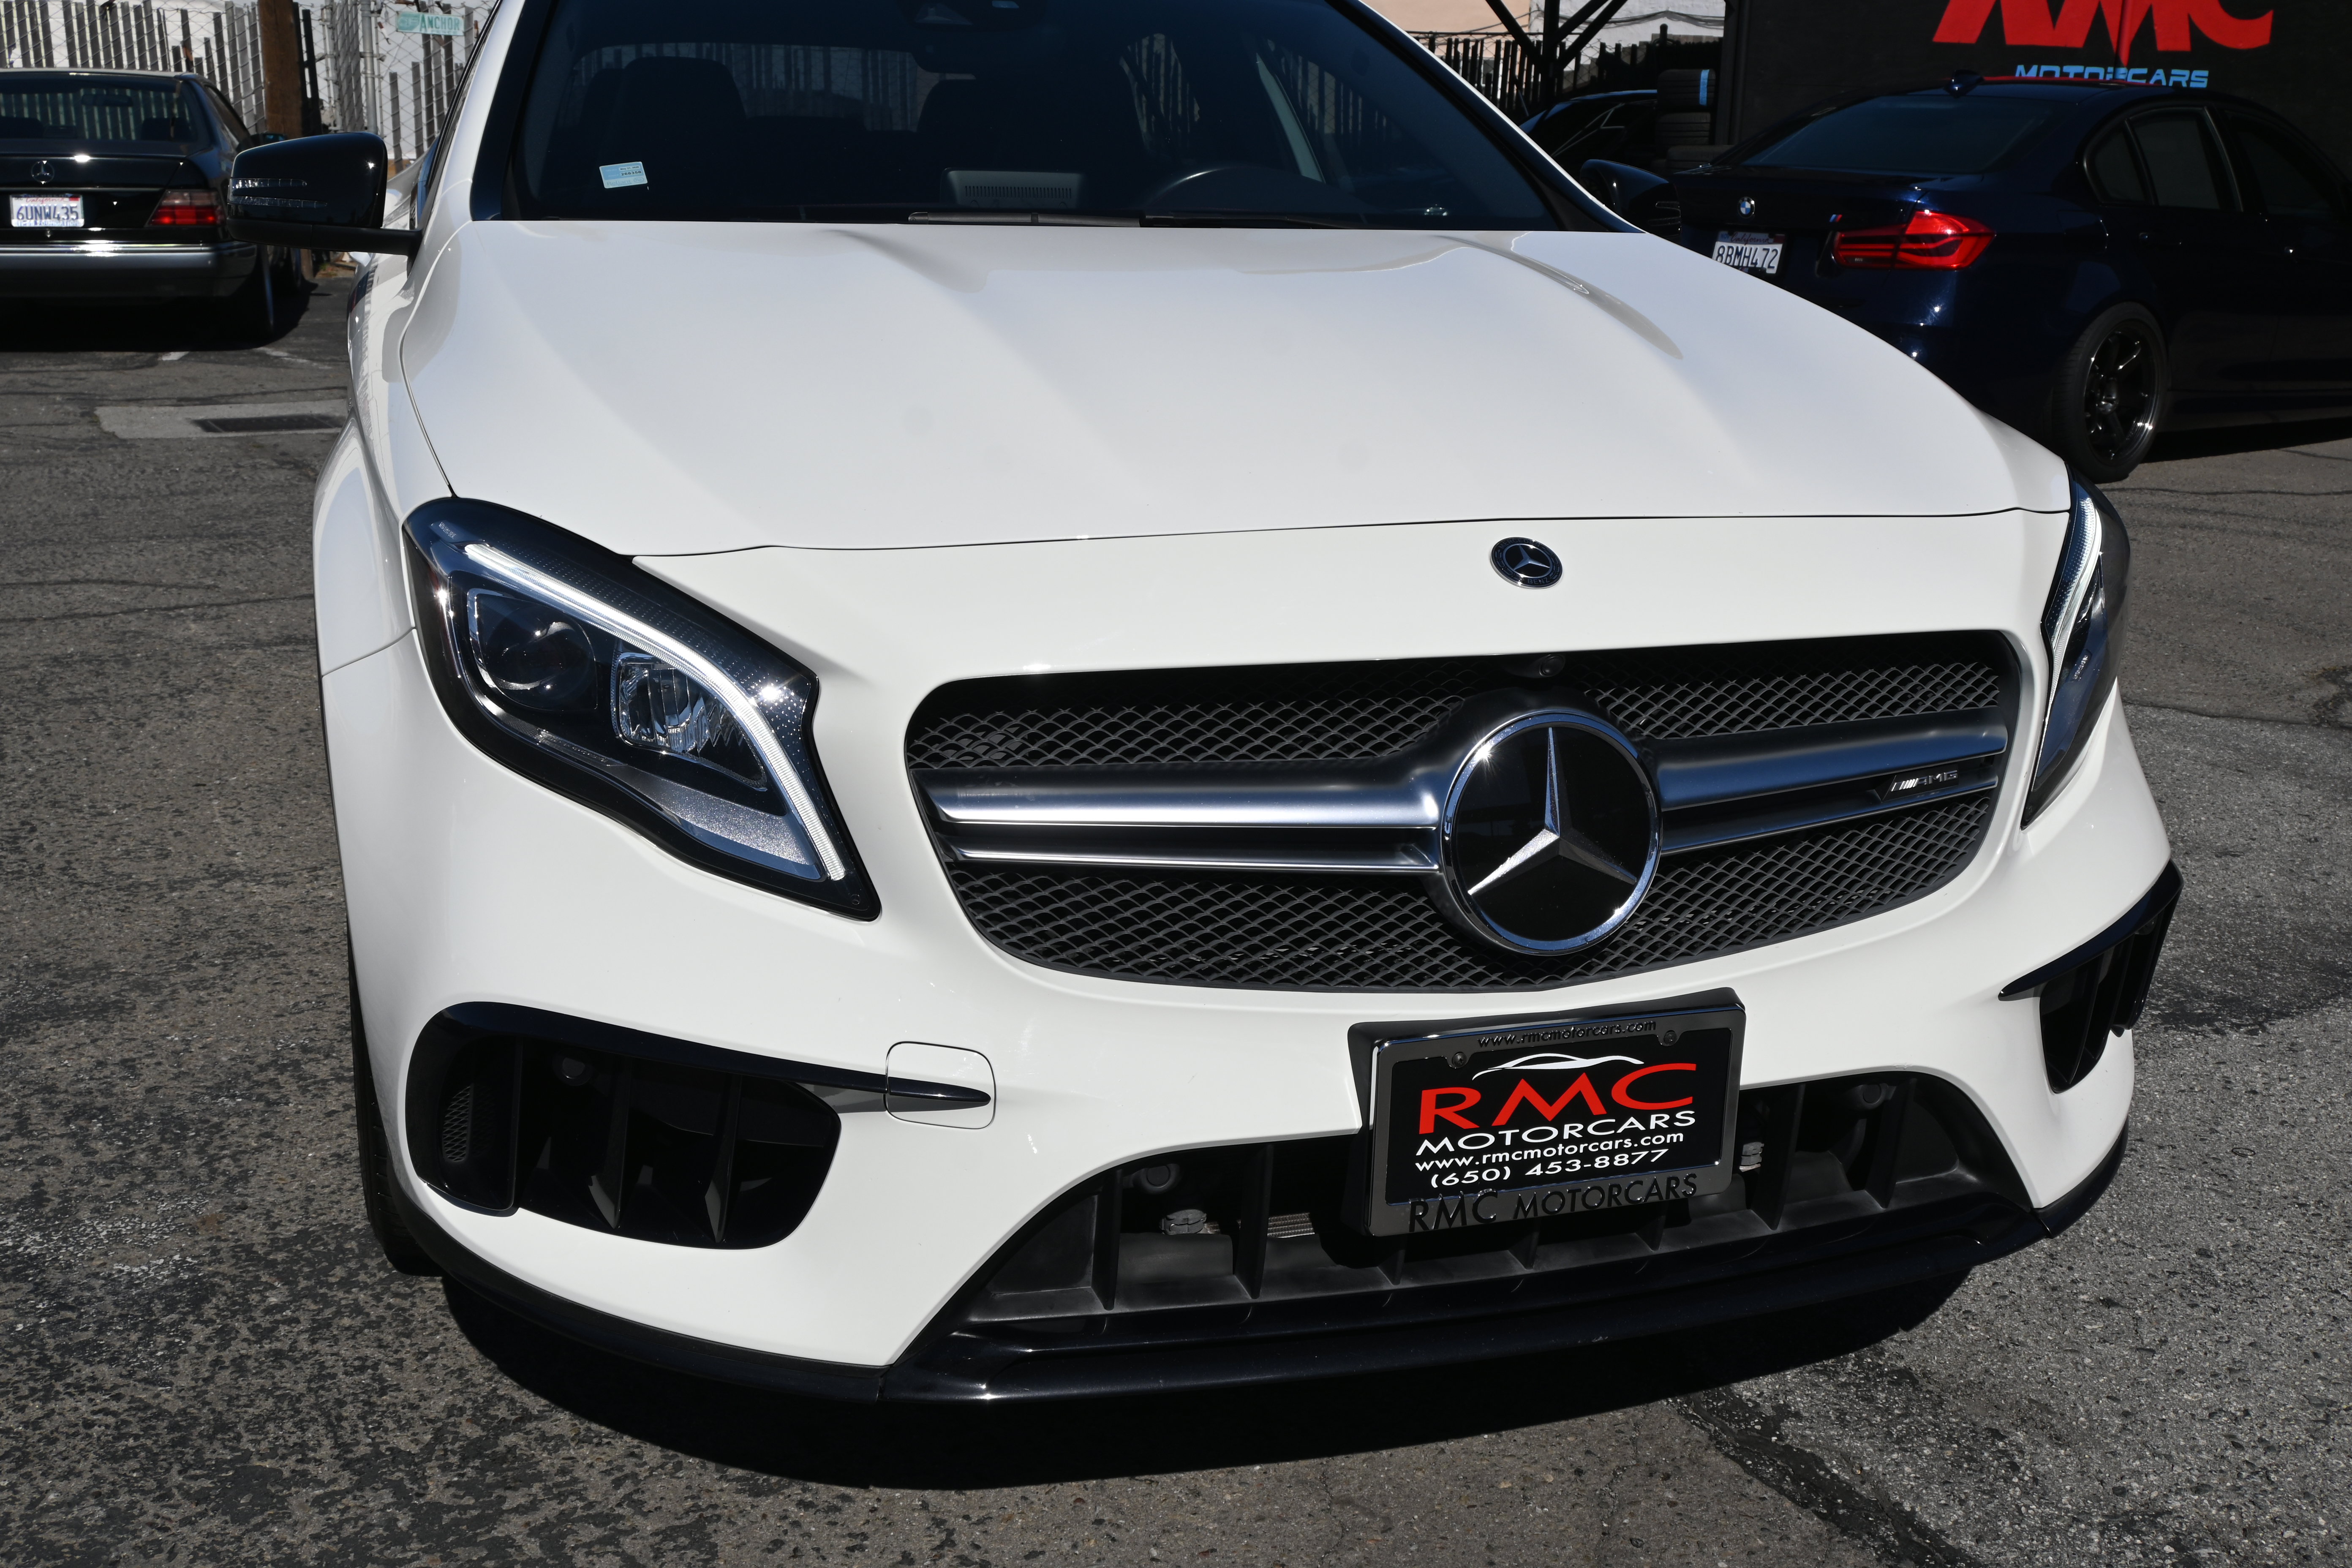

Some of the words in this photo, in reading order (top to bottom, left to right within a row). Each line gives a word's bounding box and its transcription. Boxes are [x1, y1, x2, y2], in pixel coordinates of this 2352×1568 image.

[419, 14, 460, 32] ANCHOR
[16, 205, 79, 220] 6UNW435
[1731, 232, 1774, 246] California
[1716, 245, 1779, 269] 8BMH472
[1477, 1020, 1657, 1048] www.rmcmotorcars.com
[1418, 1062, 1697, 1135] RMC
[1415, 1111, 1696, 1156] MOTORCARS
[1415, 1133, 1684, 1172] www.rmcmotorcars.com
[1431, 1166, 1511, 1188] (650)
[1524, 1148, 1669, 1176] 453-8877
[1409, 1188, 1498, 1232] RMC
[1513, 1173, 1697, 1220] MOTORCARS
